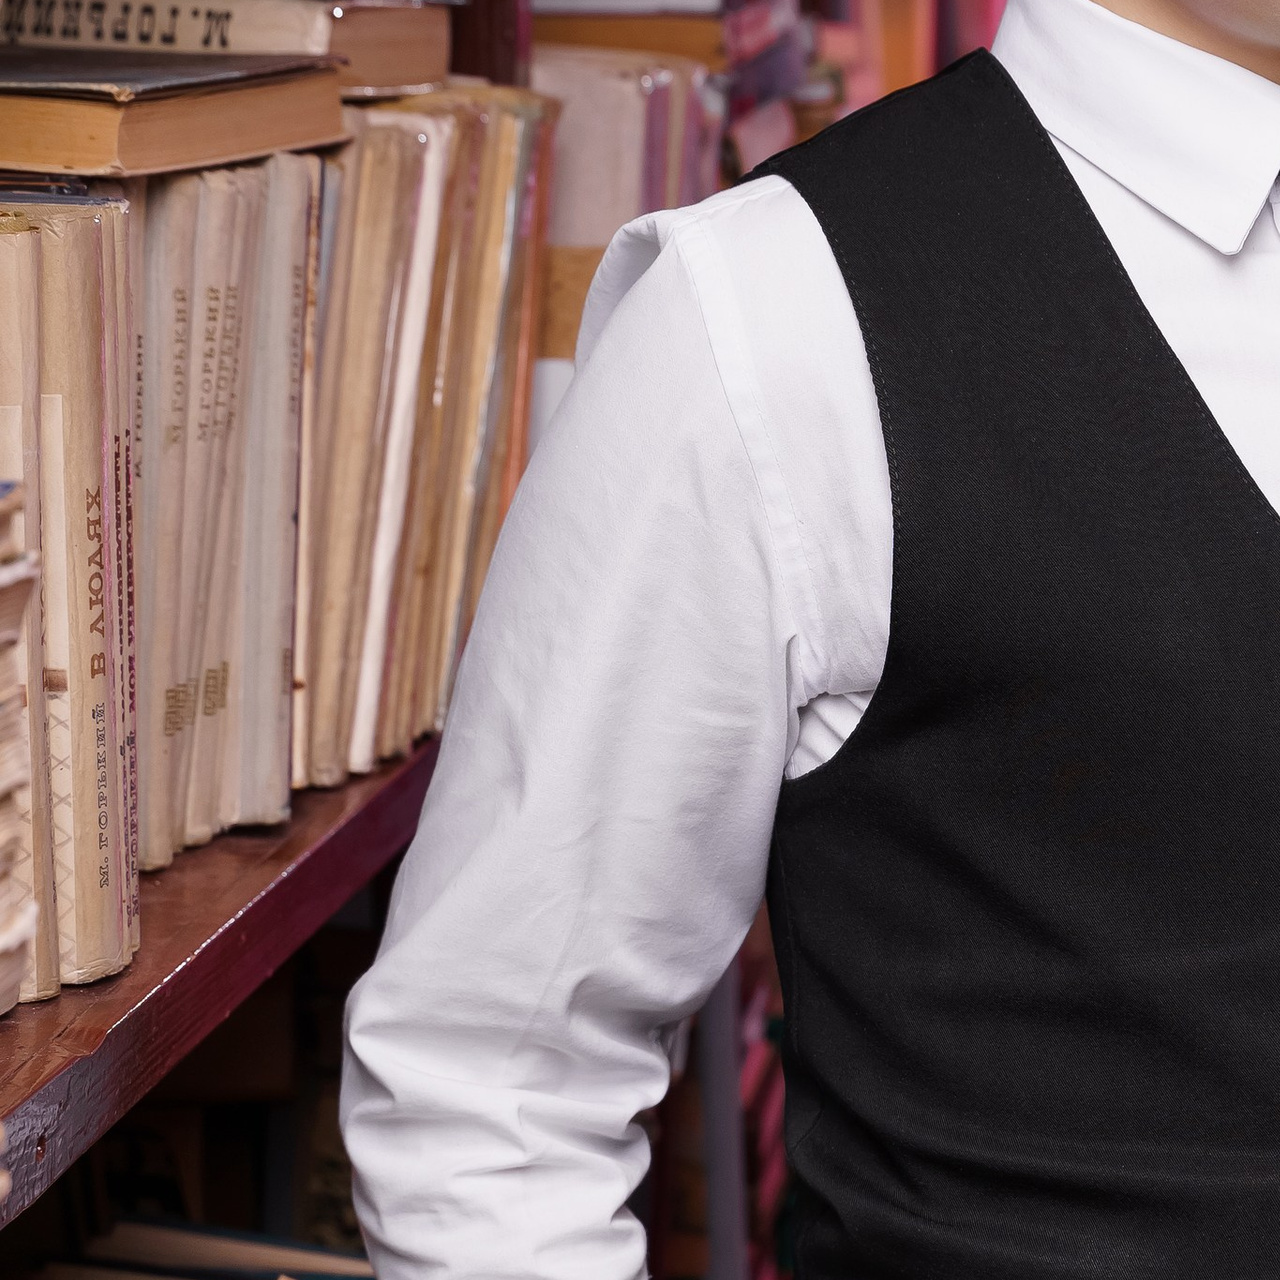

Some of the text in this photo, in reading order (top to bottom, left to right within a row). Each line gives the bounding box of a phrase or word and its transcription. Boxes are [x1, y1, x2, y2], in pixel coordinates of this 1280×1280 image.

[86, 485, 110, 888] М. ГОРЬКИЙ В ЛЮДЯХ
